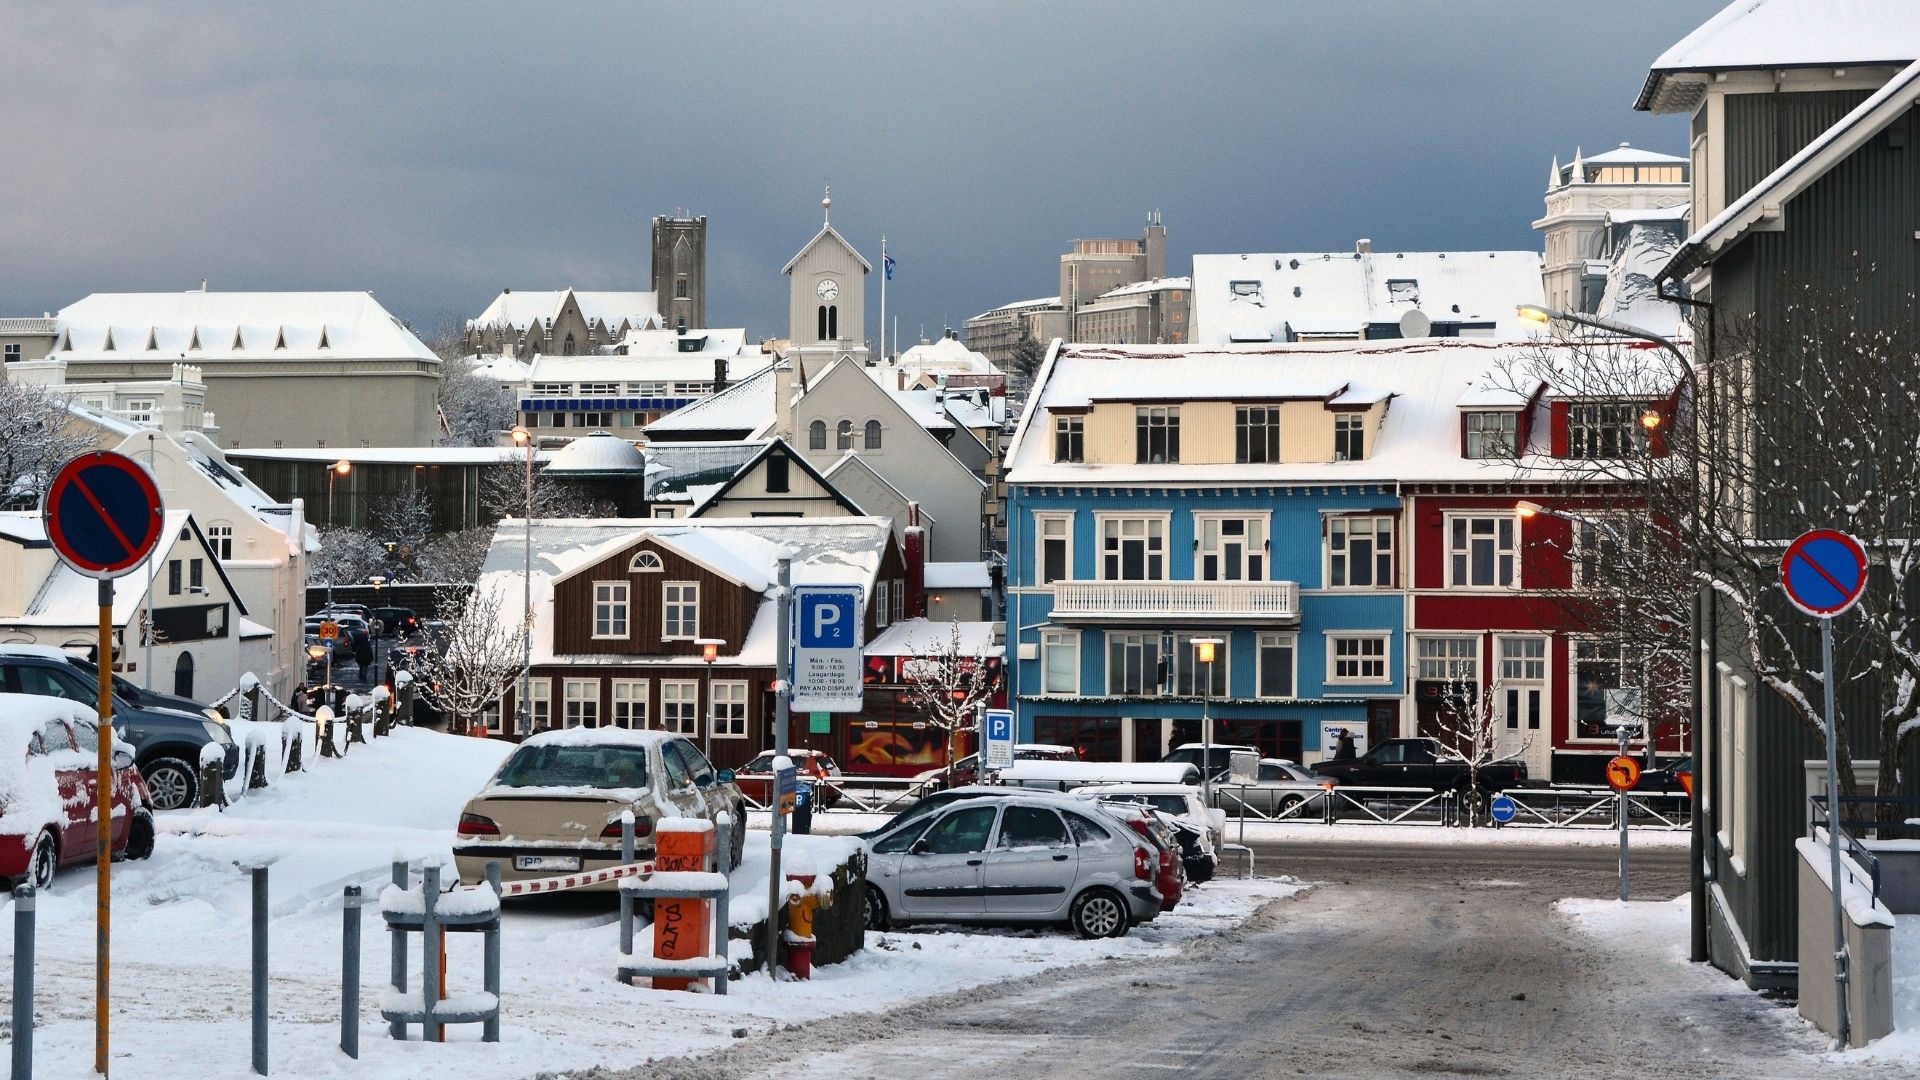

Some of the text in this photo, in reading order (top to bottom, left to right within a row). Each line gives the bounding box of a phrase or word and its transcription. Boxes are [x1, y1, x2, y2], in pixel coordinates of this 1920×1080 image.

[814, 603, 841, 638] P
[833, 627, 840, 638] 2
[993, 719, 1005, 736] P
